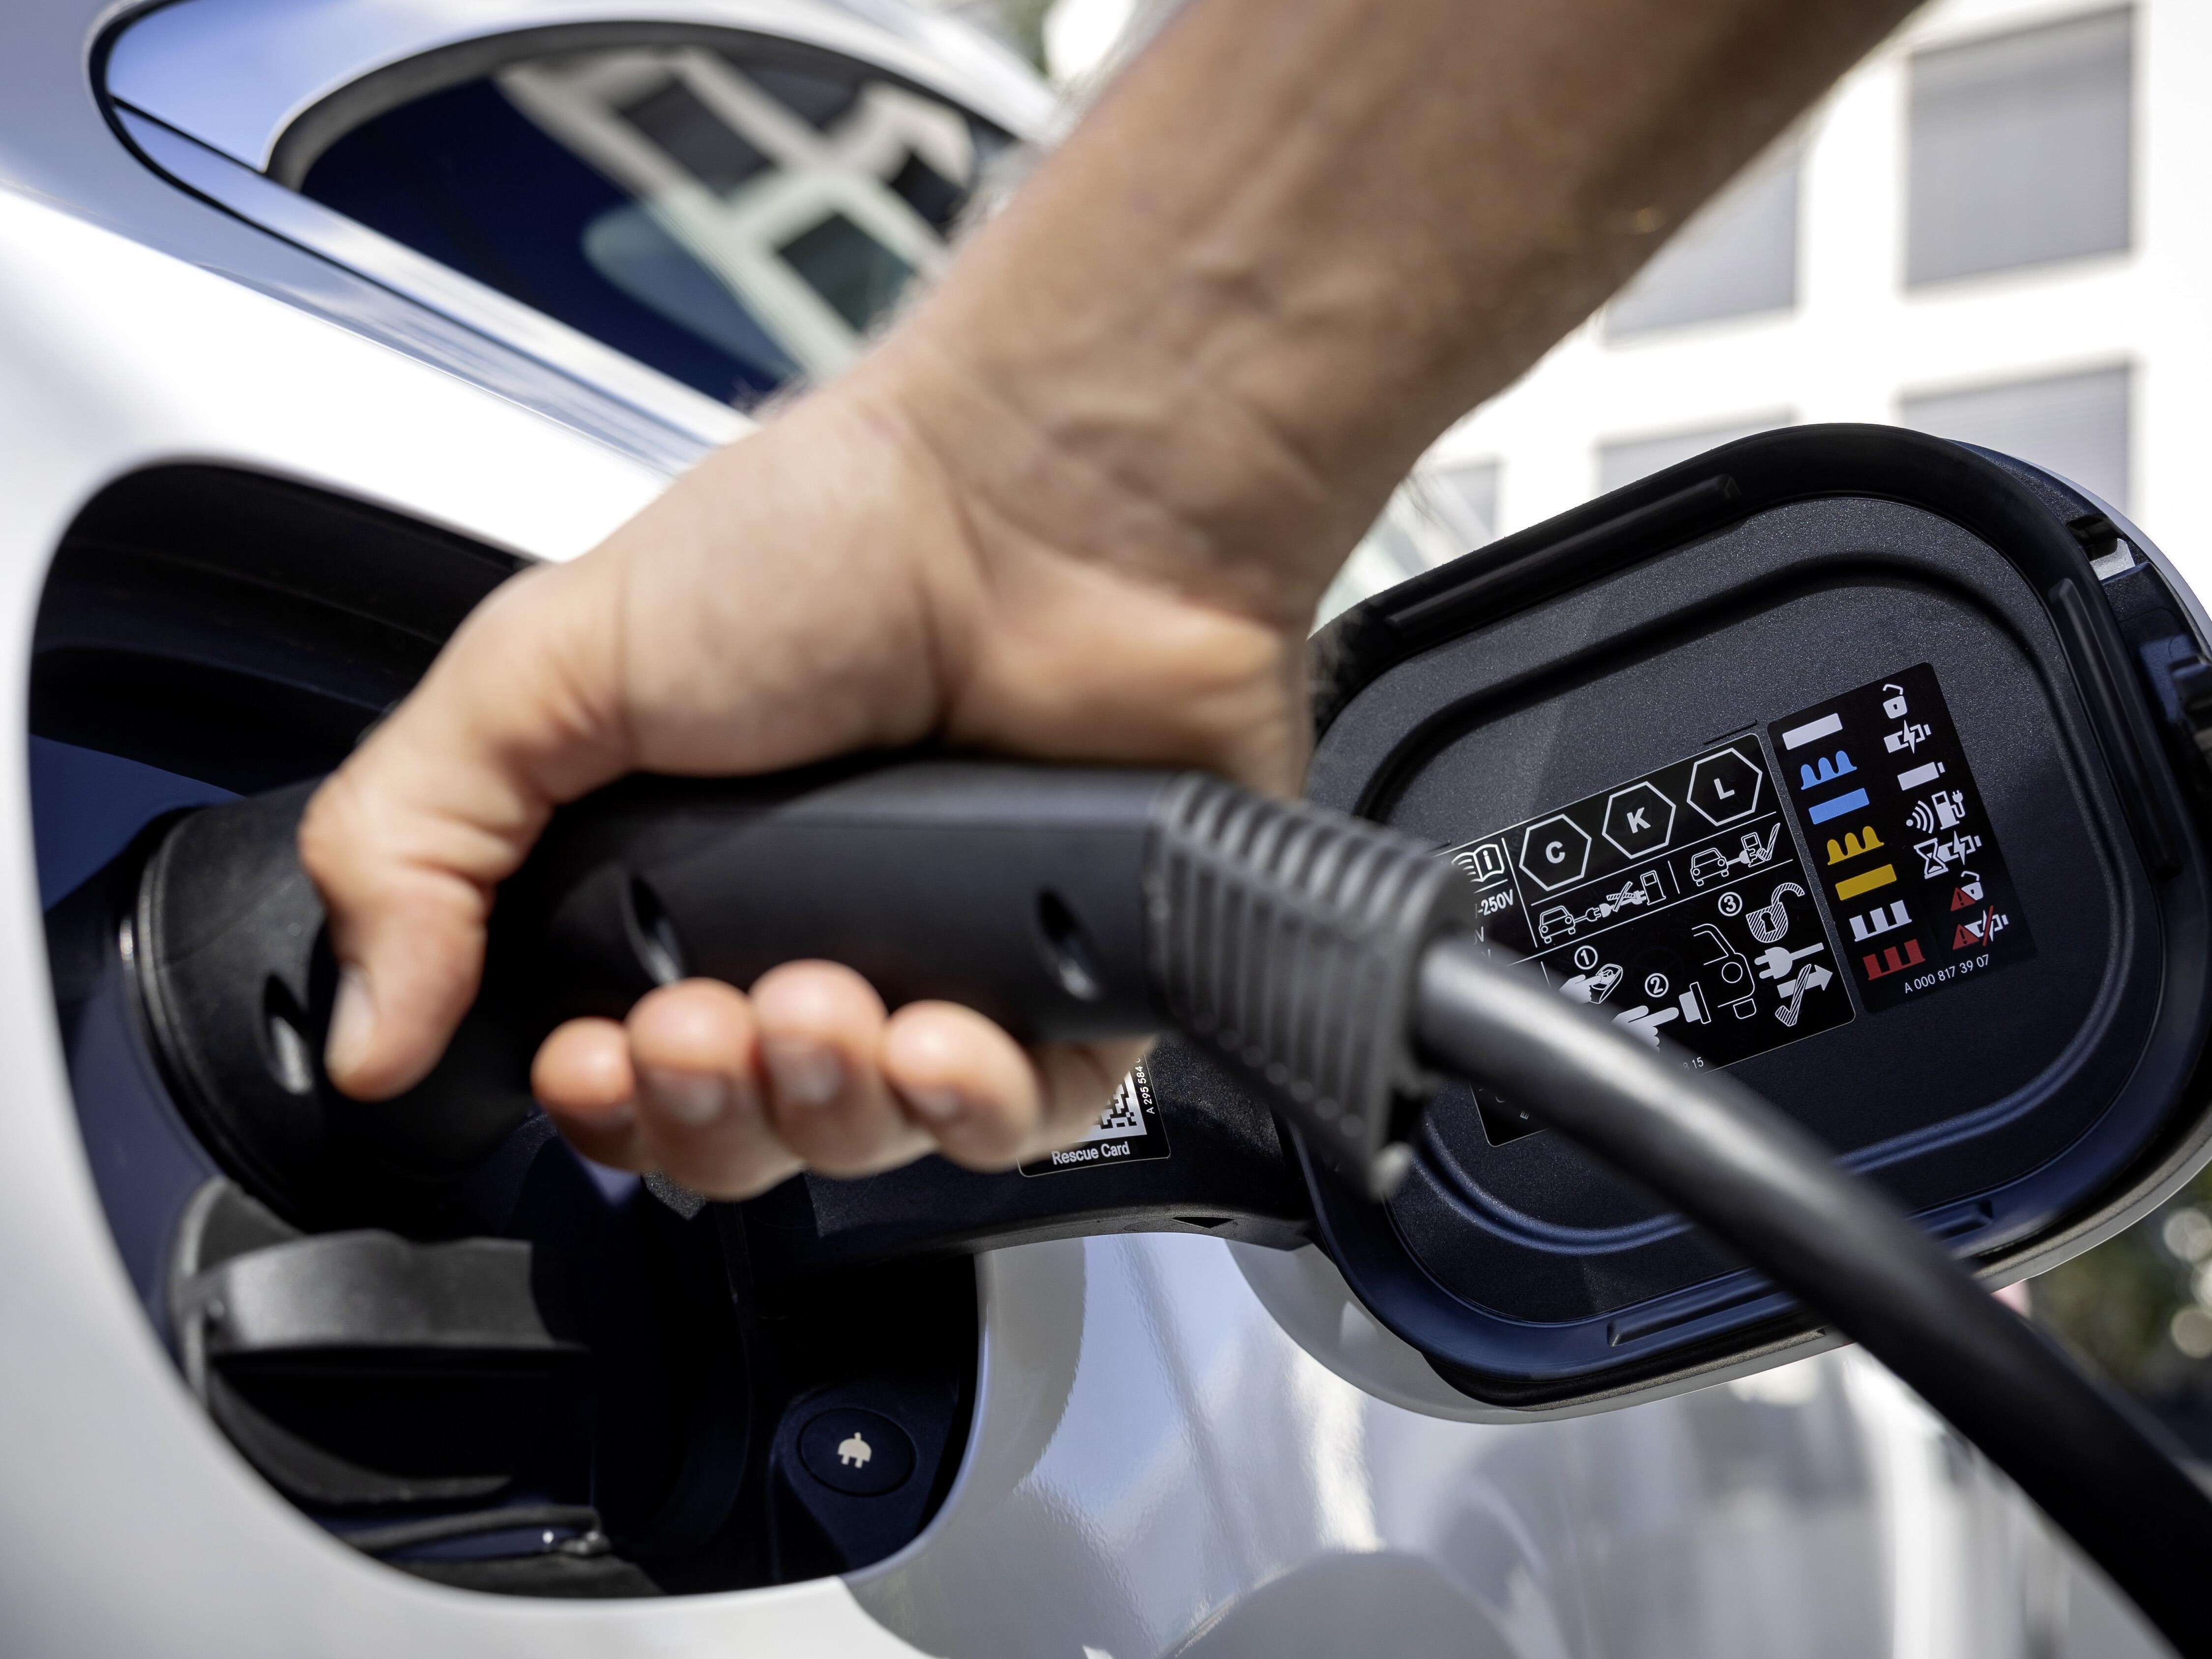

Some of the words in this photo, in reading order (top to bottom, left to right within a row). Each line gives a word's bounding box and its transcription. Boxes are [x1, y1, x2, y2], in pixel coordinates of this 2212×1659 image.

[1714, 778, 1735, 800] L
[1627, 807, 1651, 834] K
[1545, 841, 1566, 864] C
[1476, 889, 1513, 919] -250V
[1724, 896, 1736, 912] 3
[1905, 982, 1913, 993] A
[1914, 974, 1935, 989] 000
[1938, 966, 1955, 981] 817
[1959, 960, 1973, 973] 39
[1977, 954, 1989, 967] 07
[1650, 977, 1663, 993] 2
[1691, 1056, 1704, 1069] 15
[1135, 1066, 1146, 1084] 584
[1140, 1086, 1152, 1105] 295
[1051, 1148, 1099, 1165] Rescue
[1101, 1141, 1130, 1157] Card
